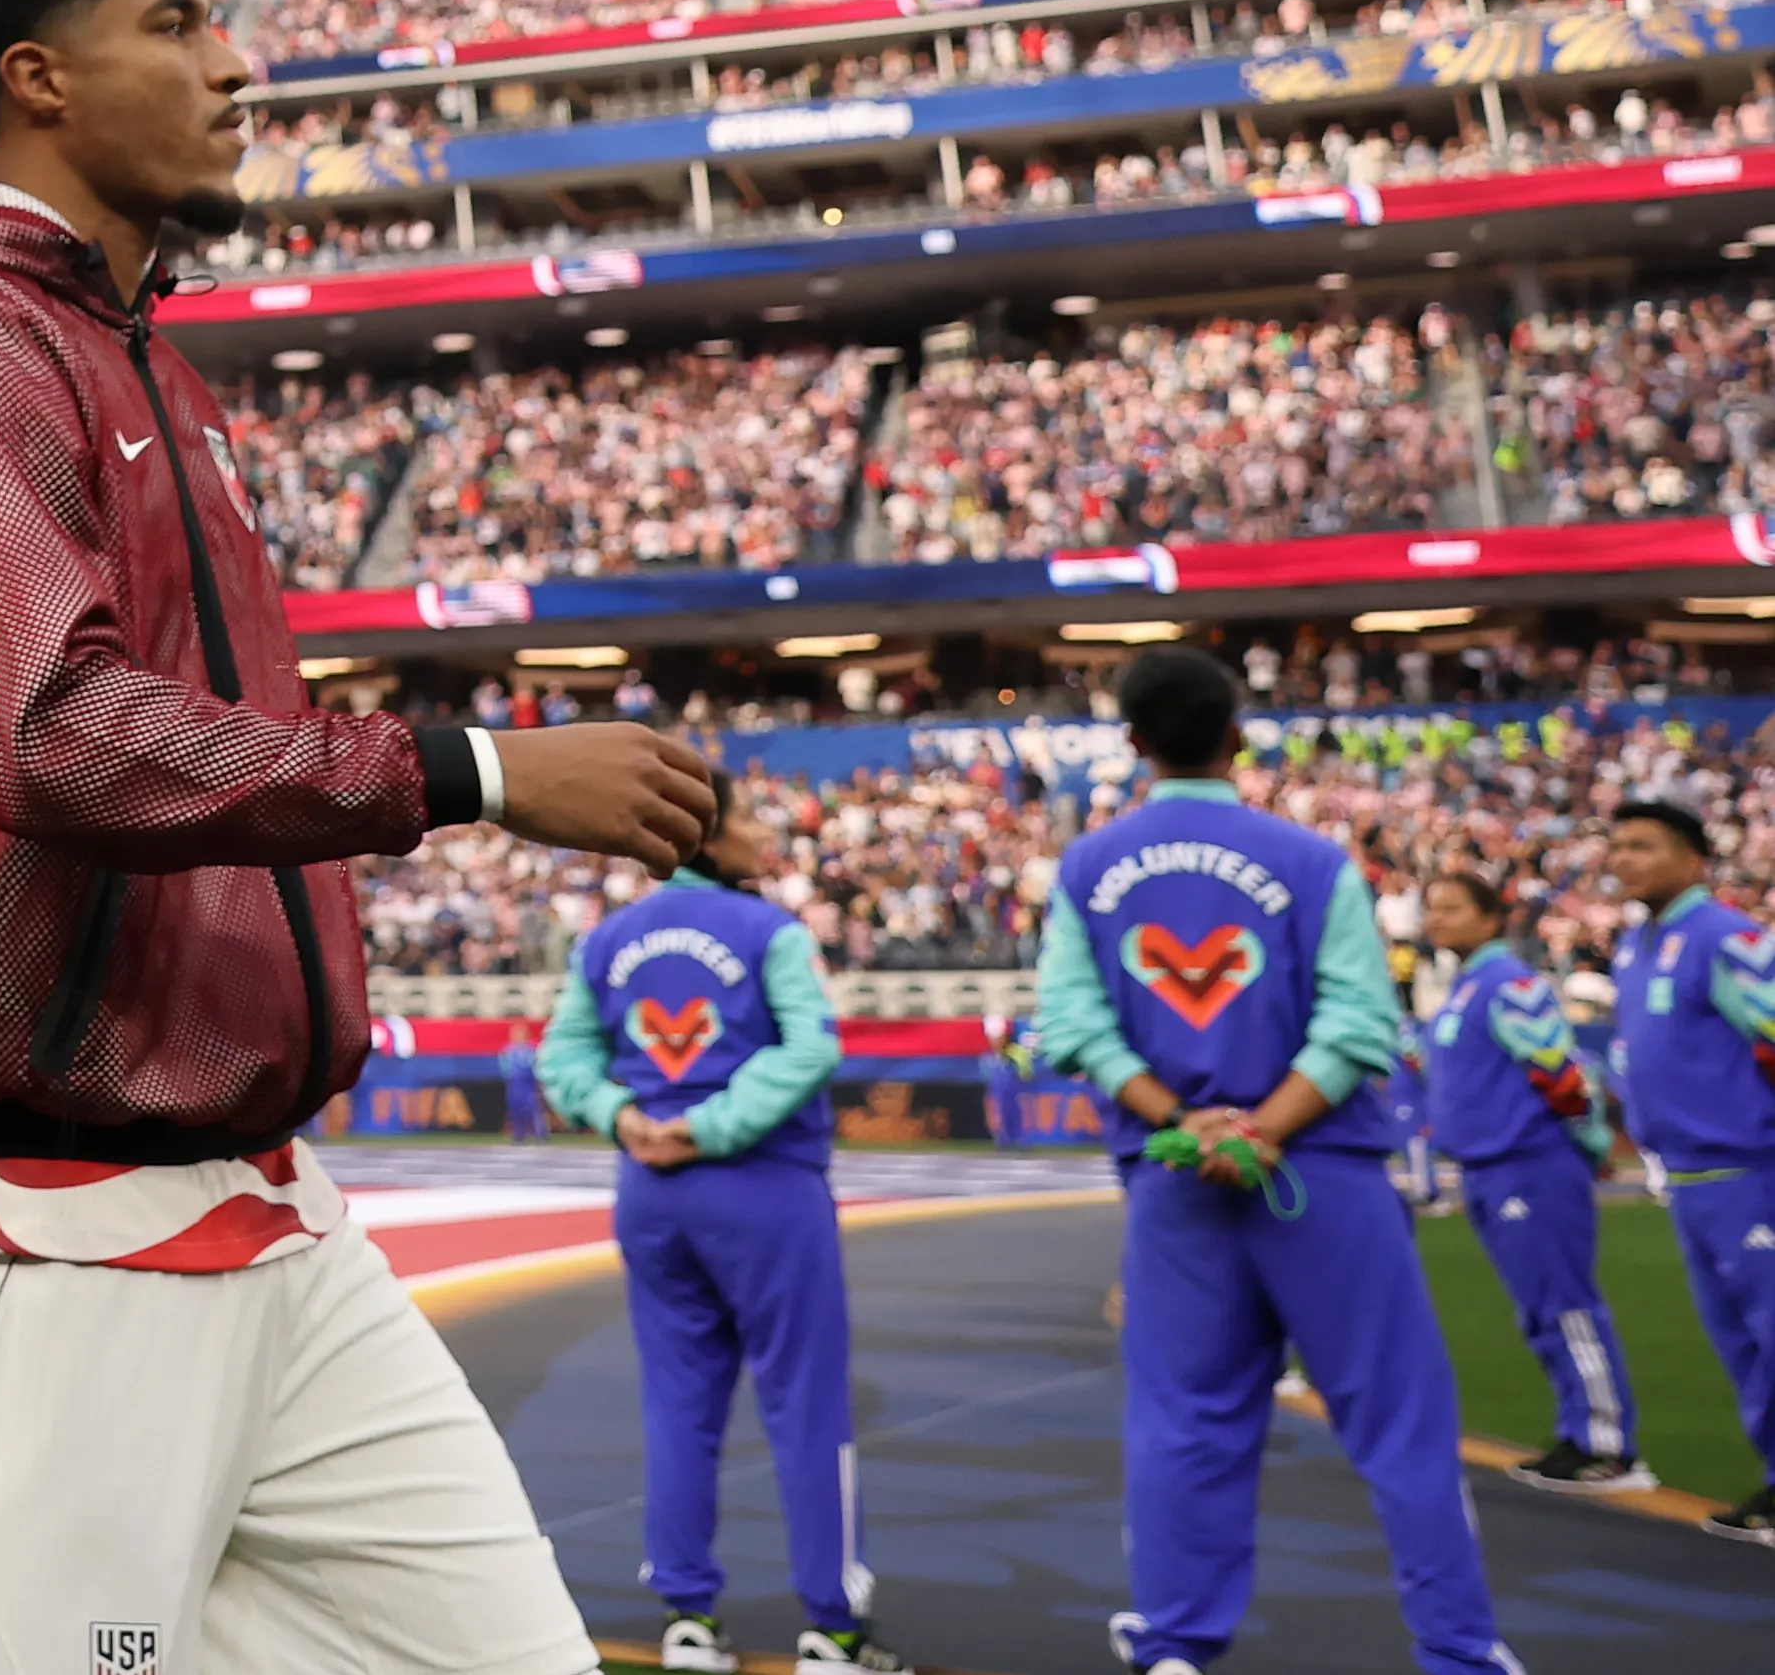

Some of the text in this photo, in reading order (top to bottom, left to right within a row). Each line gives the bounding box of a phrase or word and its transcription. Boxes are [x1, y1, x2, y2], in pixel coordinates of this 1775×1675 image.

[1087, 840, 1293, 917] VOLUNTEER
[606, 927, 748, 989] VOLUNTEER
[371, 1086, 474, 1130] FIFA
[97, 1629, 155, 1670] USA
